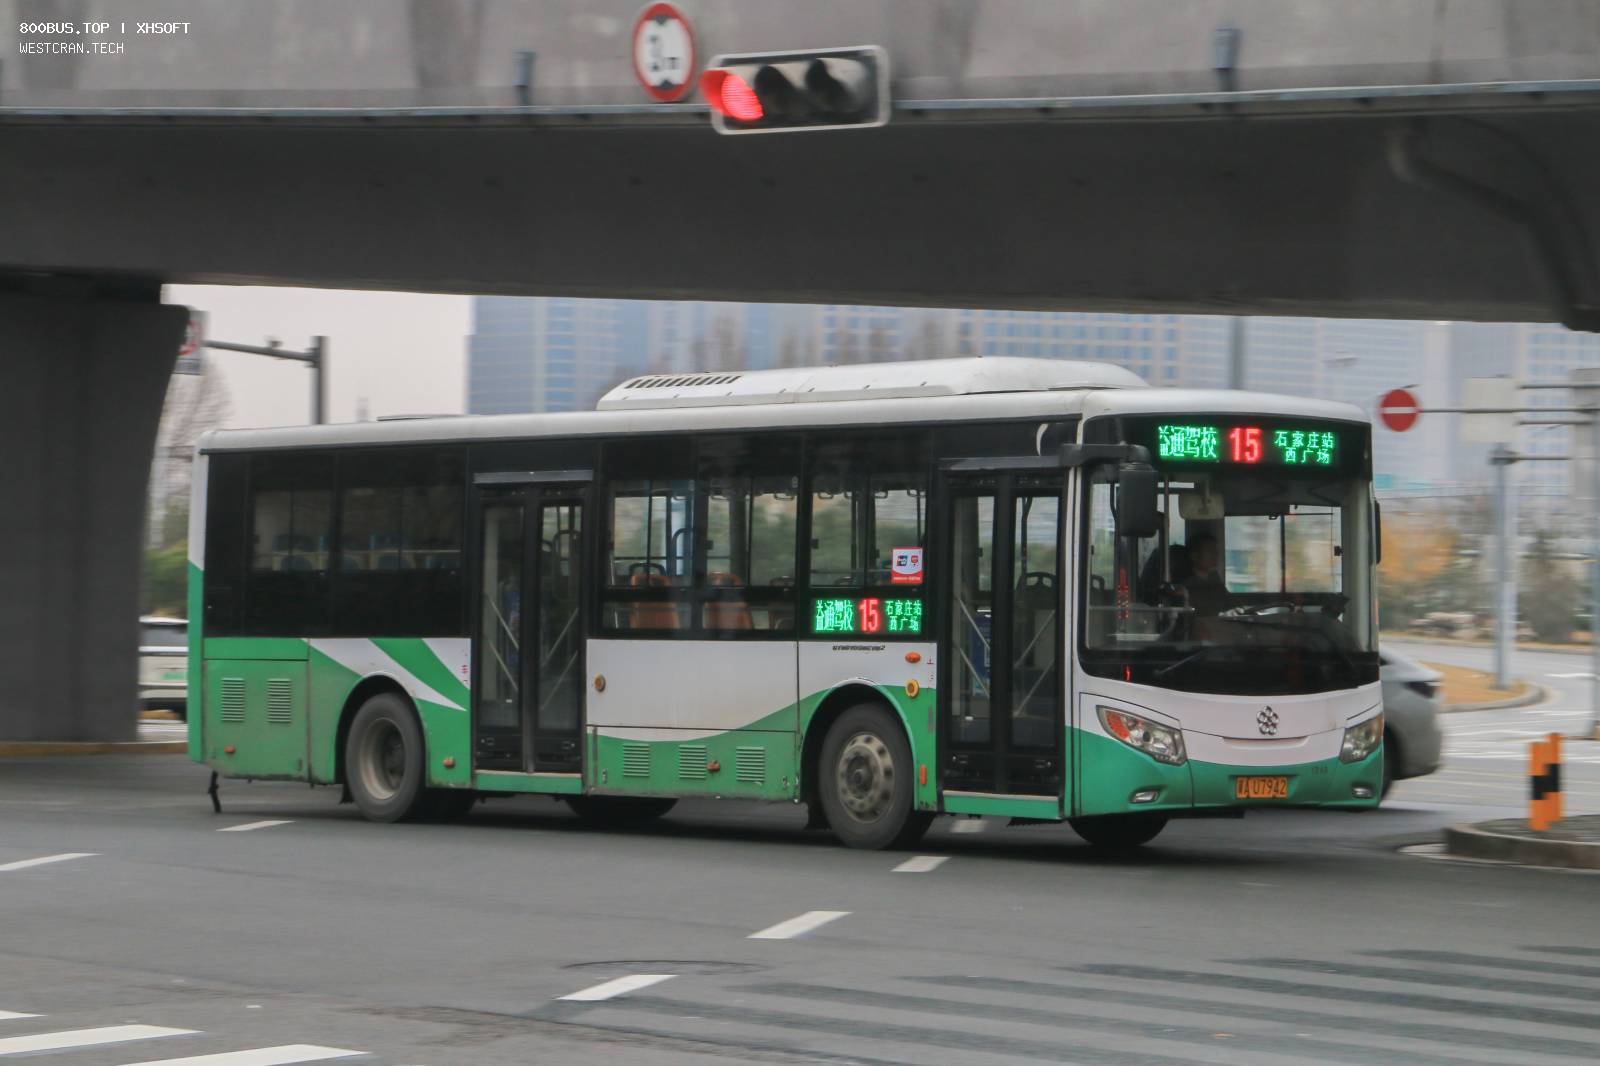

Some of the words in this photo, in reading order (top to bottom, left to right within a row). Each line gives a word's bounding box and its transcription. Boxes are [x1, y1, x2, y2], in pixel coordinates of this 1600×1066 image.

[1229, 427, 1263, 463] 15
[1274, 430, 1335, 448] 石家庄站
[1285, 447, 1330, 464] 西广场
[859, 598, 880, 632] 15
[885, 599, 922, 616] 石家庄站
[889, 615, 920, 631] 西广场
